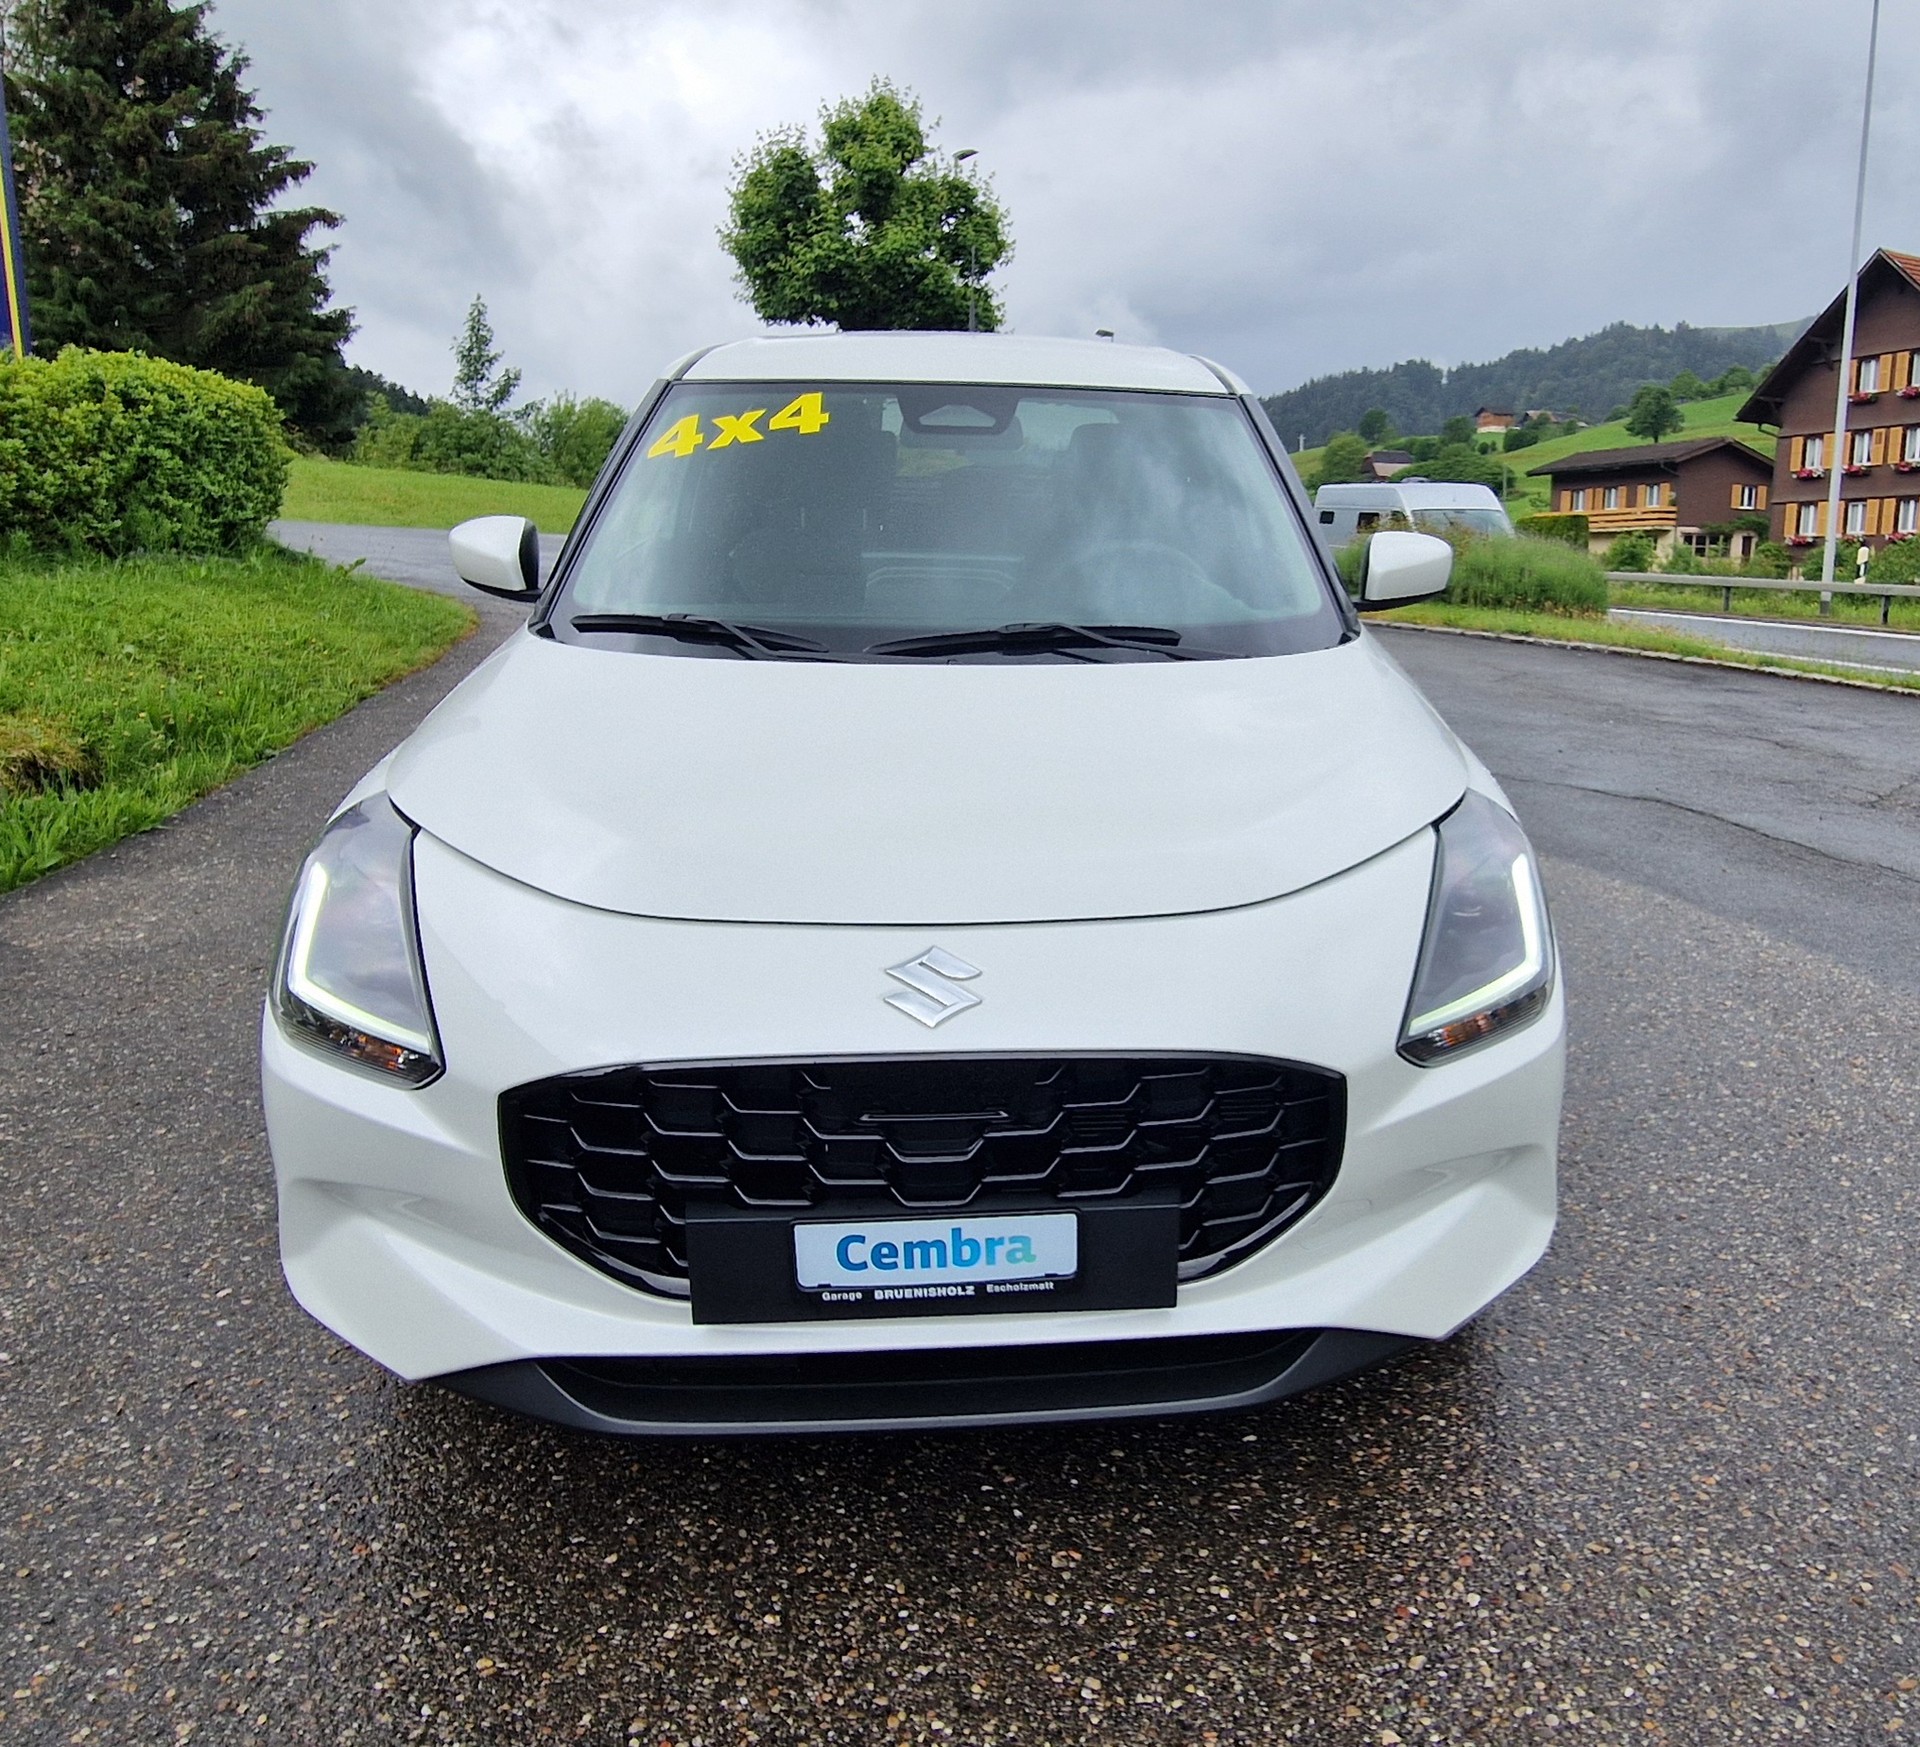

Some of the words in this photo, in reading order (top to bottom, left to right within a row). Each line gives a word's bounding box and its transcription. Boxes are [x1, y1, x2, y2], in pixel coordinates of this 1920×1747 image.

[647, 391, 829, 459] 4x4
[836, 1227, 1037, 1271] Cembra
[822, 1291, 862, 1301] Garage
[874, 1286, 975, 1300] BRUENISHOLZ
[986, 1281, 1054, 1293] Escholzmatt
